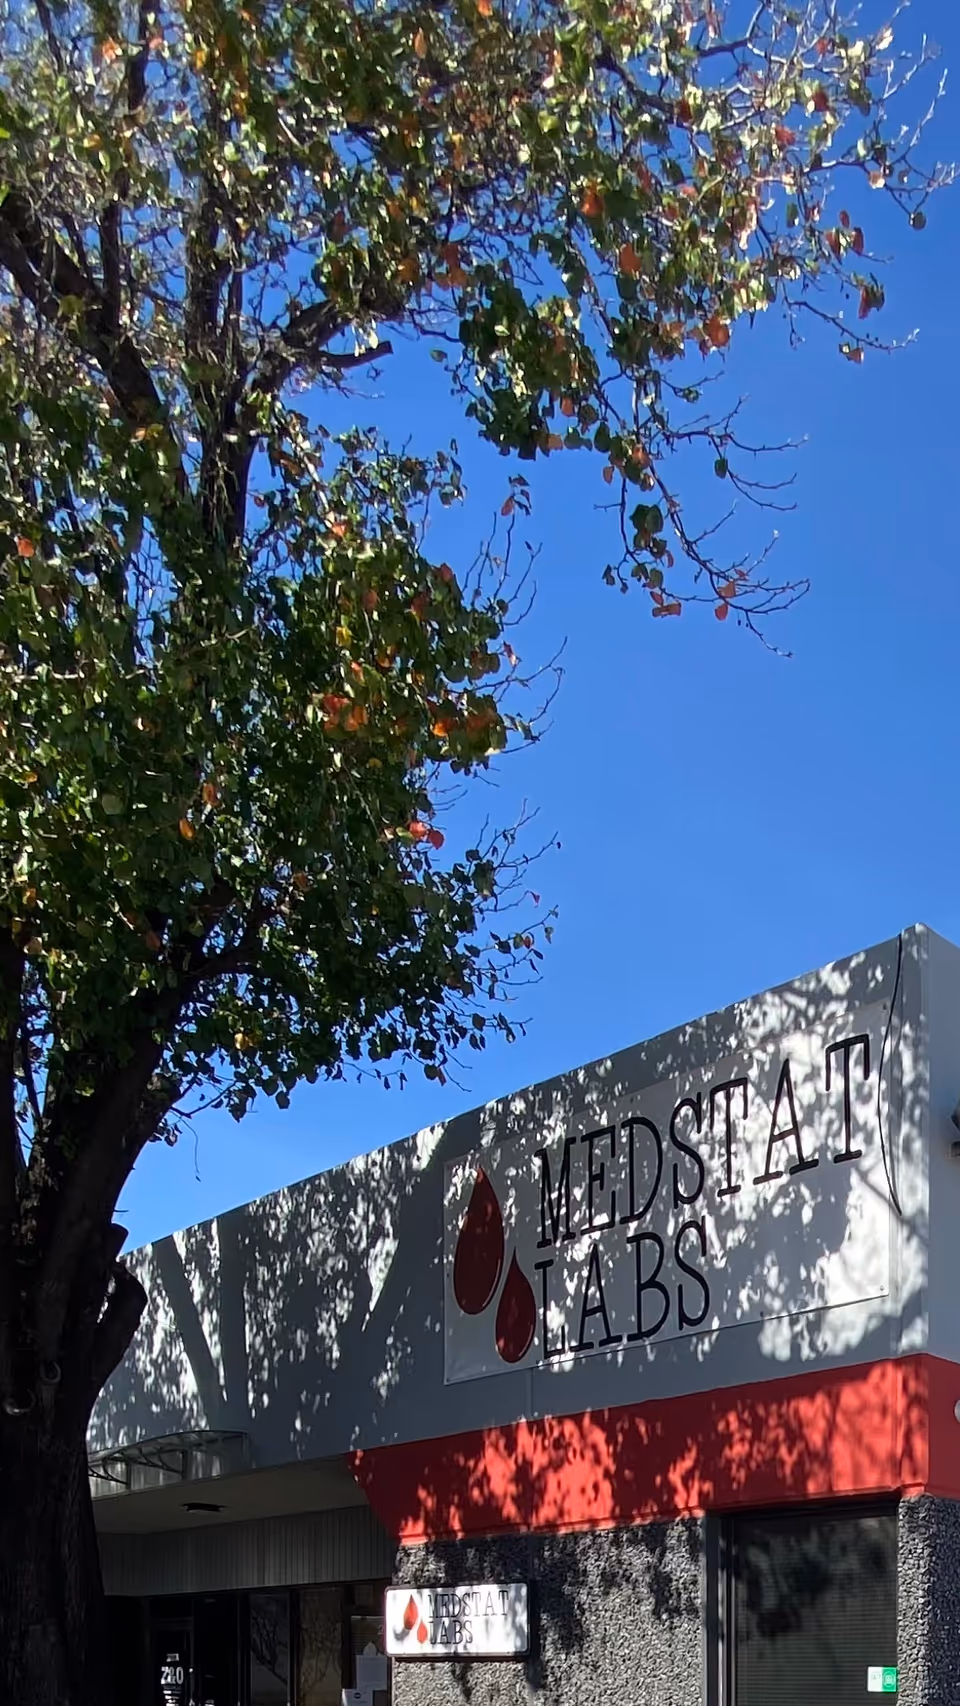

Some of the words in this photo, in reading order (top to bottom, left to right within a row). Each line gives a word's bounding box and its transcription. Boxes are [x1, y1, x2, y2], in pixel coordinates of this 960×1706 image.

[534, 1034, 869, 1248] MEDSTAT
[534, 1216, 710, 1360] LABS
[428, 1590, 508, 1618] MEDSTAT
[428, 1620, 473, 1645] LABS
